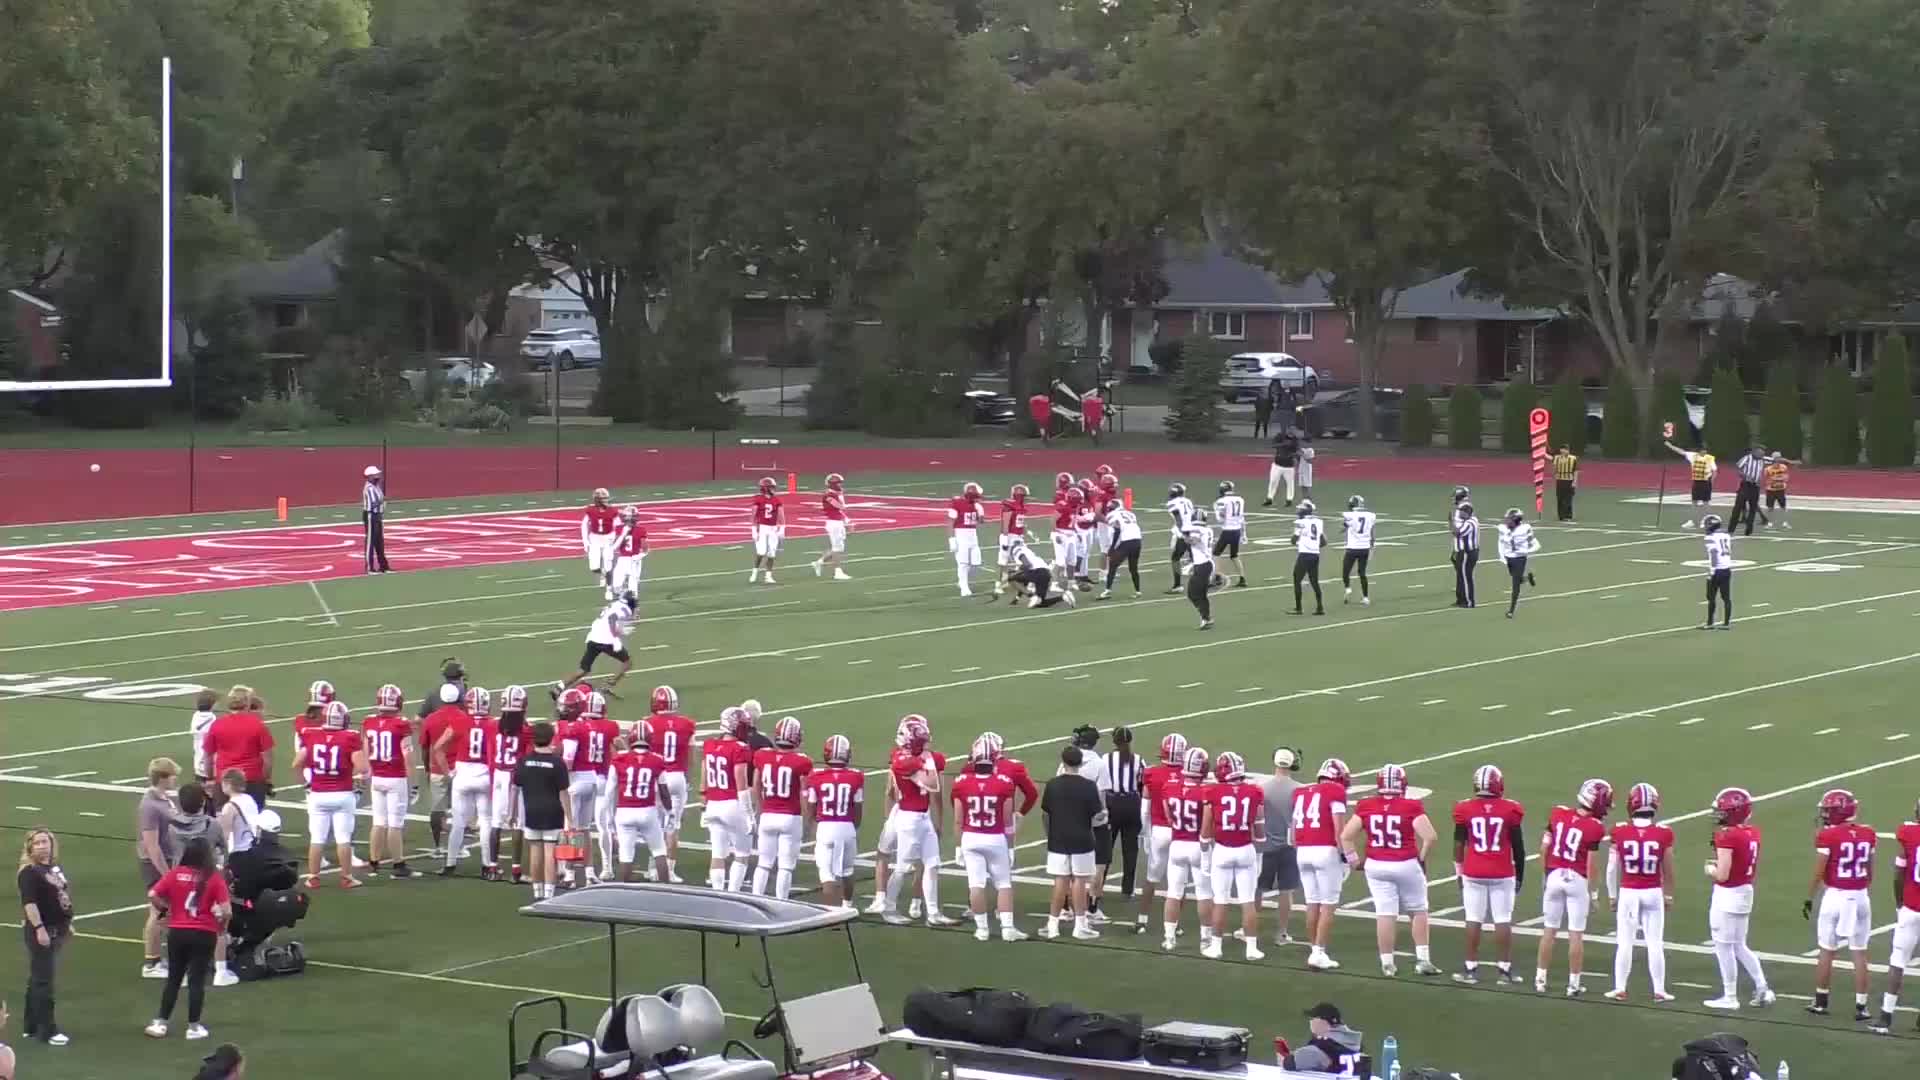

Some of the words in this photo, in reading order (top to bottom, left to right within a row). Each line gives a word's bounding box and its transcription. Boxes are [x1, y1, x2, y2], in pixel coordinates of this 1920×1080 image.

[598, 518, 604, 533] 1
[764, 503, 774, 518] 2
[1358, 516, 1366, 534] 7
[625, 535, 633, 552] 3
[1310, 523, 1318, 541] 9
[312, 743, 340, 776] 51
[366, 729, 393, 762] 30
[468, 727, 484, 759] 8
[494, 732, 519, 765] 12
[663, 731, 677, 763] 0
[623, 766, 652, 799] 18
[705, 753, 729, 790] 66
[761, 763, 793, 798] 40
[820, 782, 852, 817] 20
[966, 795, 999, 828] 25
[1167, 796, 1199, 832] 35
[1220, 795, 1251, 832] 21
[1292, 792, 1321, 829] 44
[1369, 814, 1403, 849] 55
[1470, 816, 1504, 853] 97
[1551, 821, 1583, 862] 19
[1622, 839, 1660, 875] 26
[1836, 841, 1871, 878] 22
